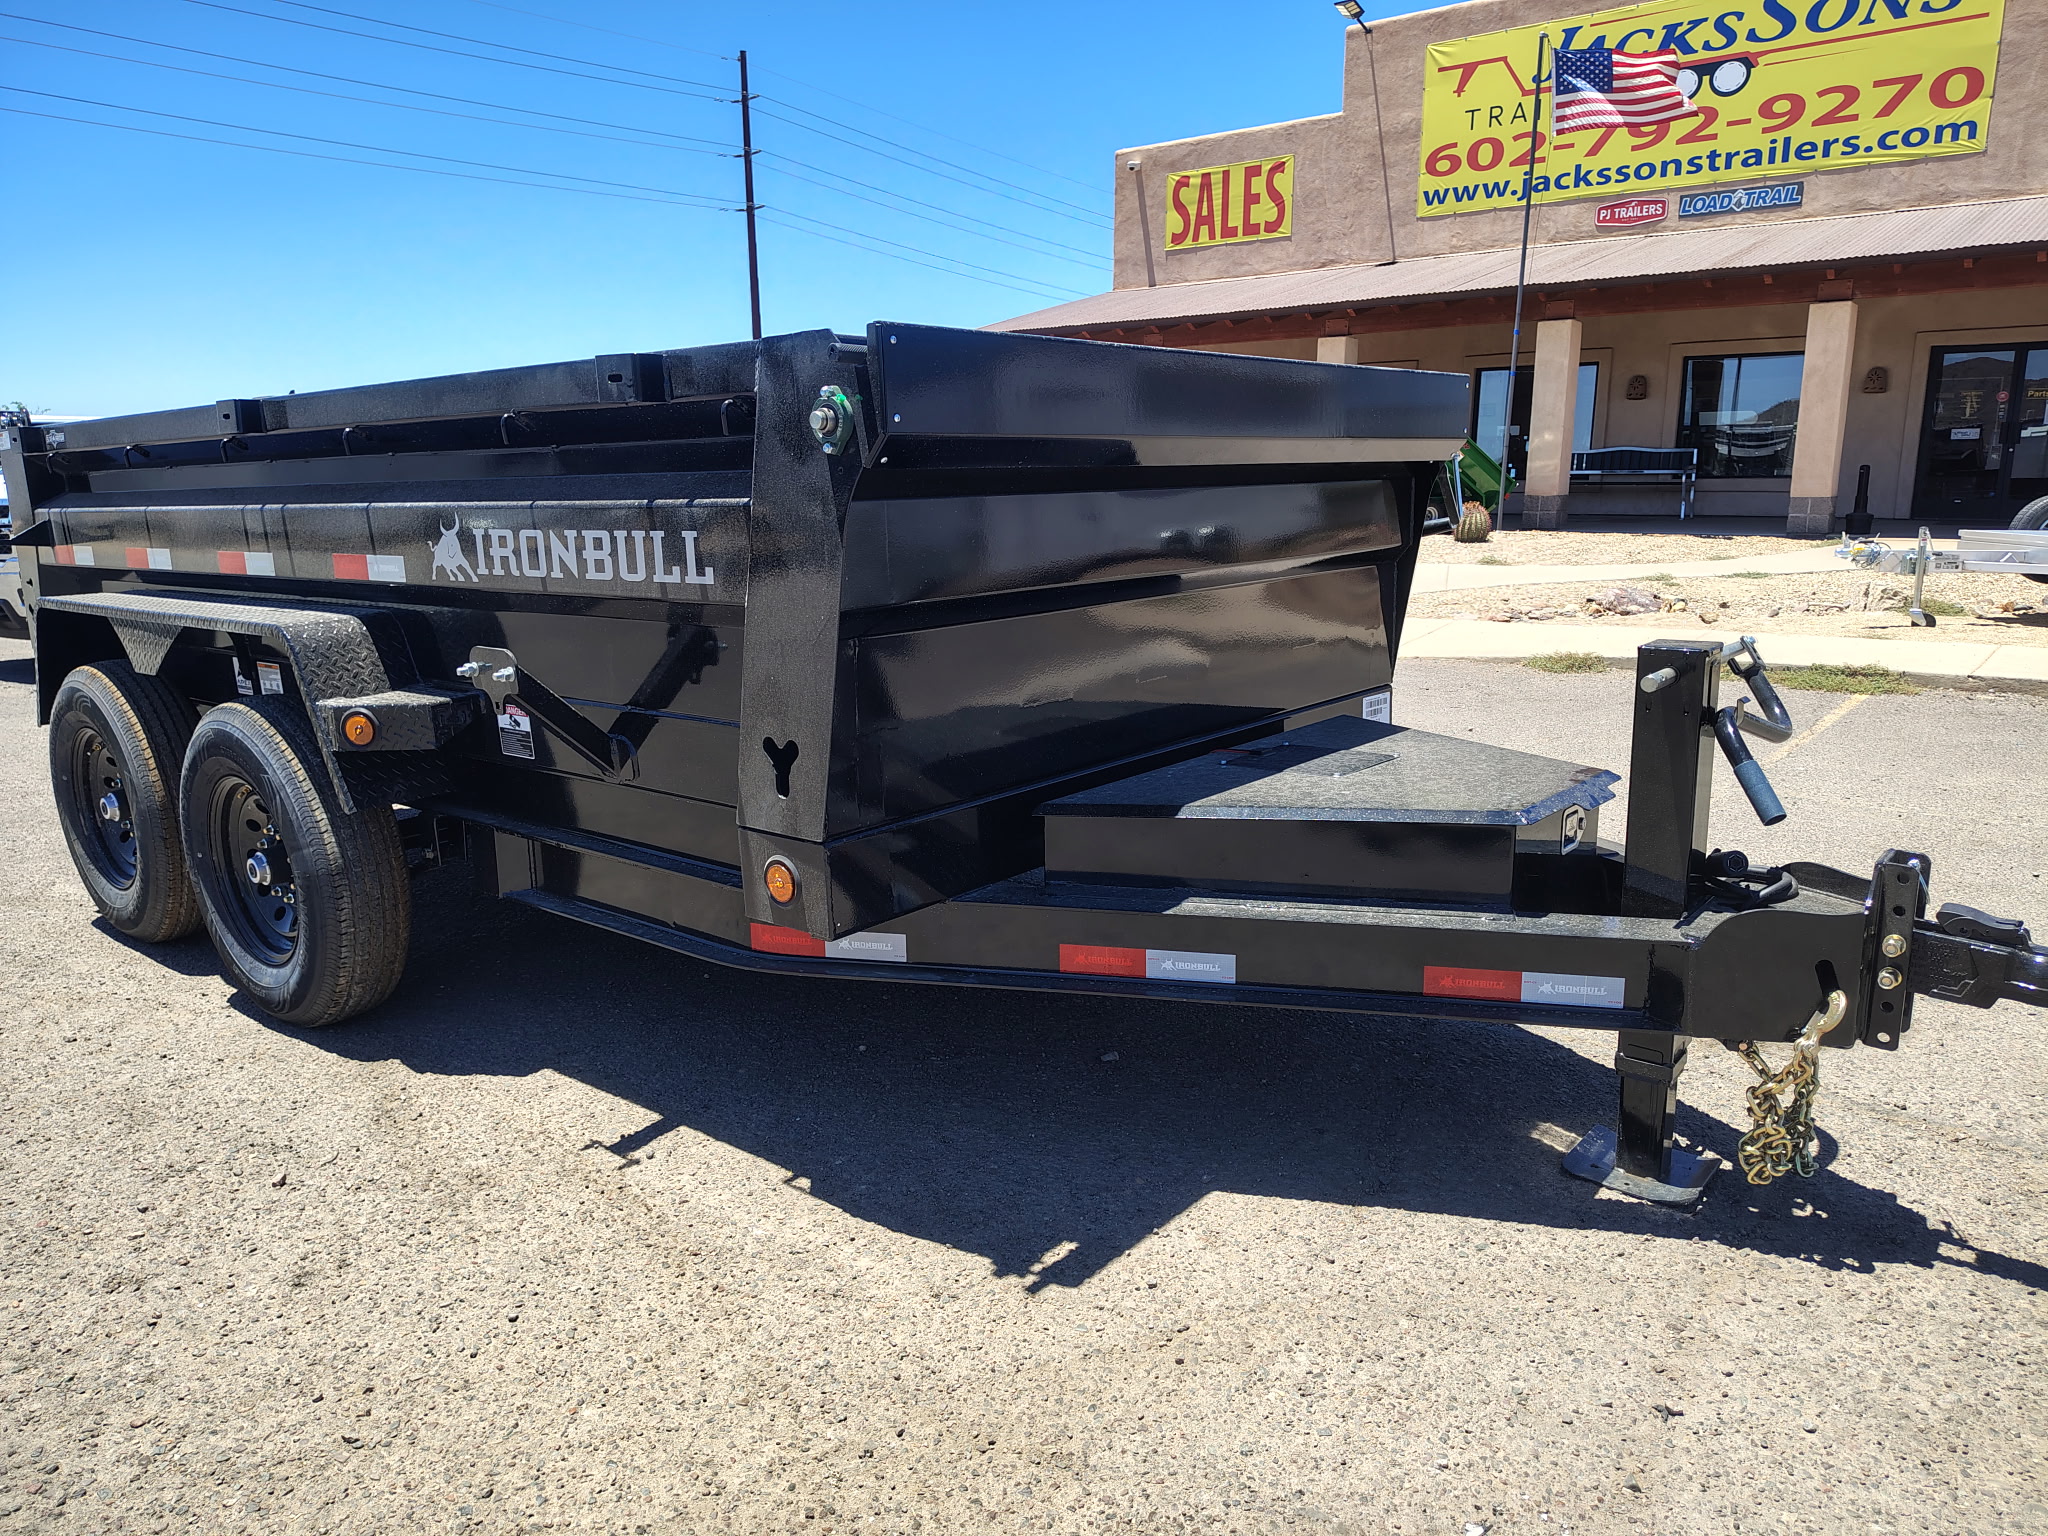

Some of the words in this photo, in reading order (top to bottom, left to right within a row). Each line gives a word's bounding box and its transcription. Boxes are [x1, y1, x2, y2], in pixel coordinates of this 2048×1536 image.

[1424, 66, 1986, 178] 602-792-9270
[1422, 119, 1979, 207] www.jackssonstrailers.com
[1170, 160, 1287, 246] SALES
[1599, 209, 1611, 221] PJ
[1614, 203, 1663, 219] TRAILERS
[1680, 193, 1734, 215] LOAD
[1743, 185, 1801, 207] TRAIL
[472, 528, 715, 585] IRONBULL
[772, 935, 813, 946] IRONBULL
[851, 941, 894, 951] IRONBULL
[1087, 955, 1133, 967] IRONBULL
[1175, 961, 1221, 972] IRONBULL
[1455, 978, 1506, 989] IRONBULL
[1554, 984, 1608, 996] IRONBULL
